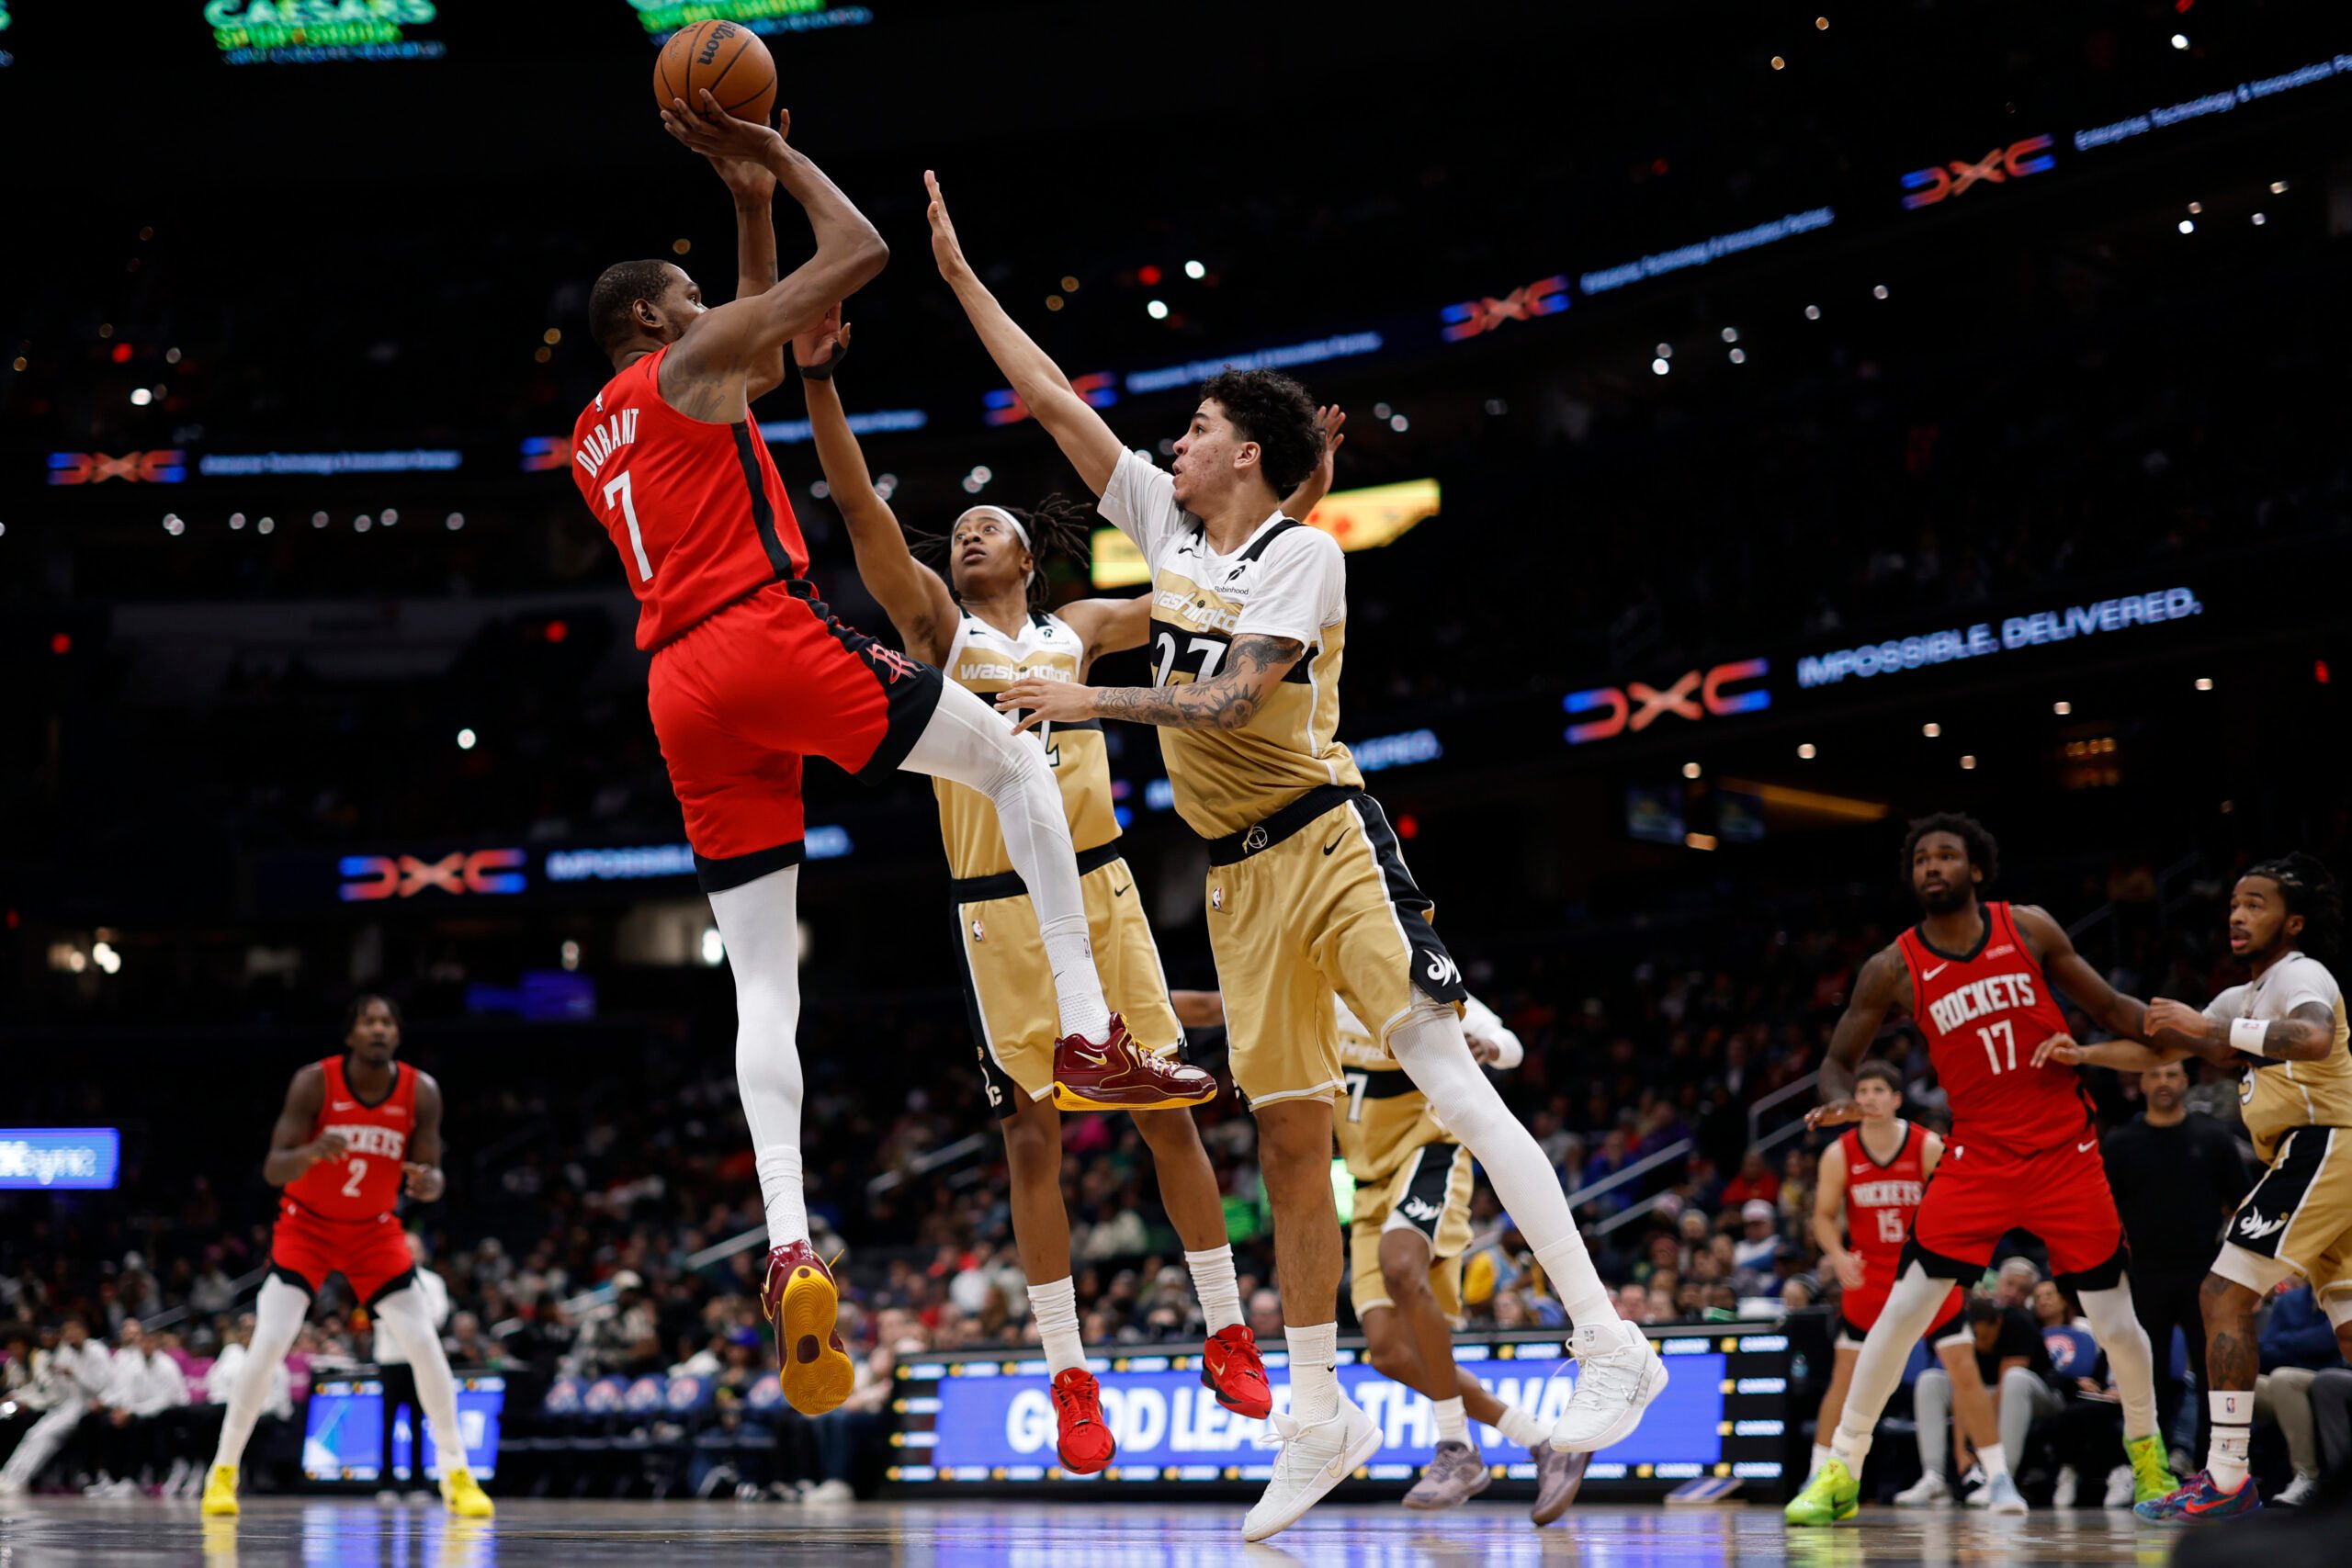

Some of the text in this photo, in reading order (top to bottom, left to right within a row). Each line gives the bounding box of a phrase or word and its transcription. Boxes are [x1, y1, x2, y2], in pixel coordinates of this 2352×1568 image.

[576, 408, 639, 479] DURANT
[603, 469, 653, 582] 7
[1152, 588, 1239, 633] washingto
[1214, 585, 1250, 596] Robinhood
[1156, 631, 1227, 689] 27
[1797, 586, 2202, 689] IMPOSSIBLE. DELIVERED.
[1928, 972, 2037, 1037] ROCKETS
[1976, 1019, 2018, 1076] 17
[323, 1123, 405, 1161] CKETS
[341, 1157, 368, 1198] 2
[1849, 1179, 1923, 1208] ROCKETS
[1876, 1208, 1905, 1244] 15
[1006, 1387, 1168, 1454] GOD
[1355, 1380, 1468, 1450] TH
[1480, 1376, 1577, 1449] WA
